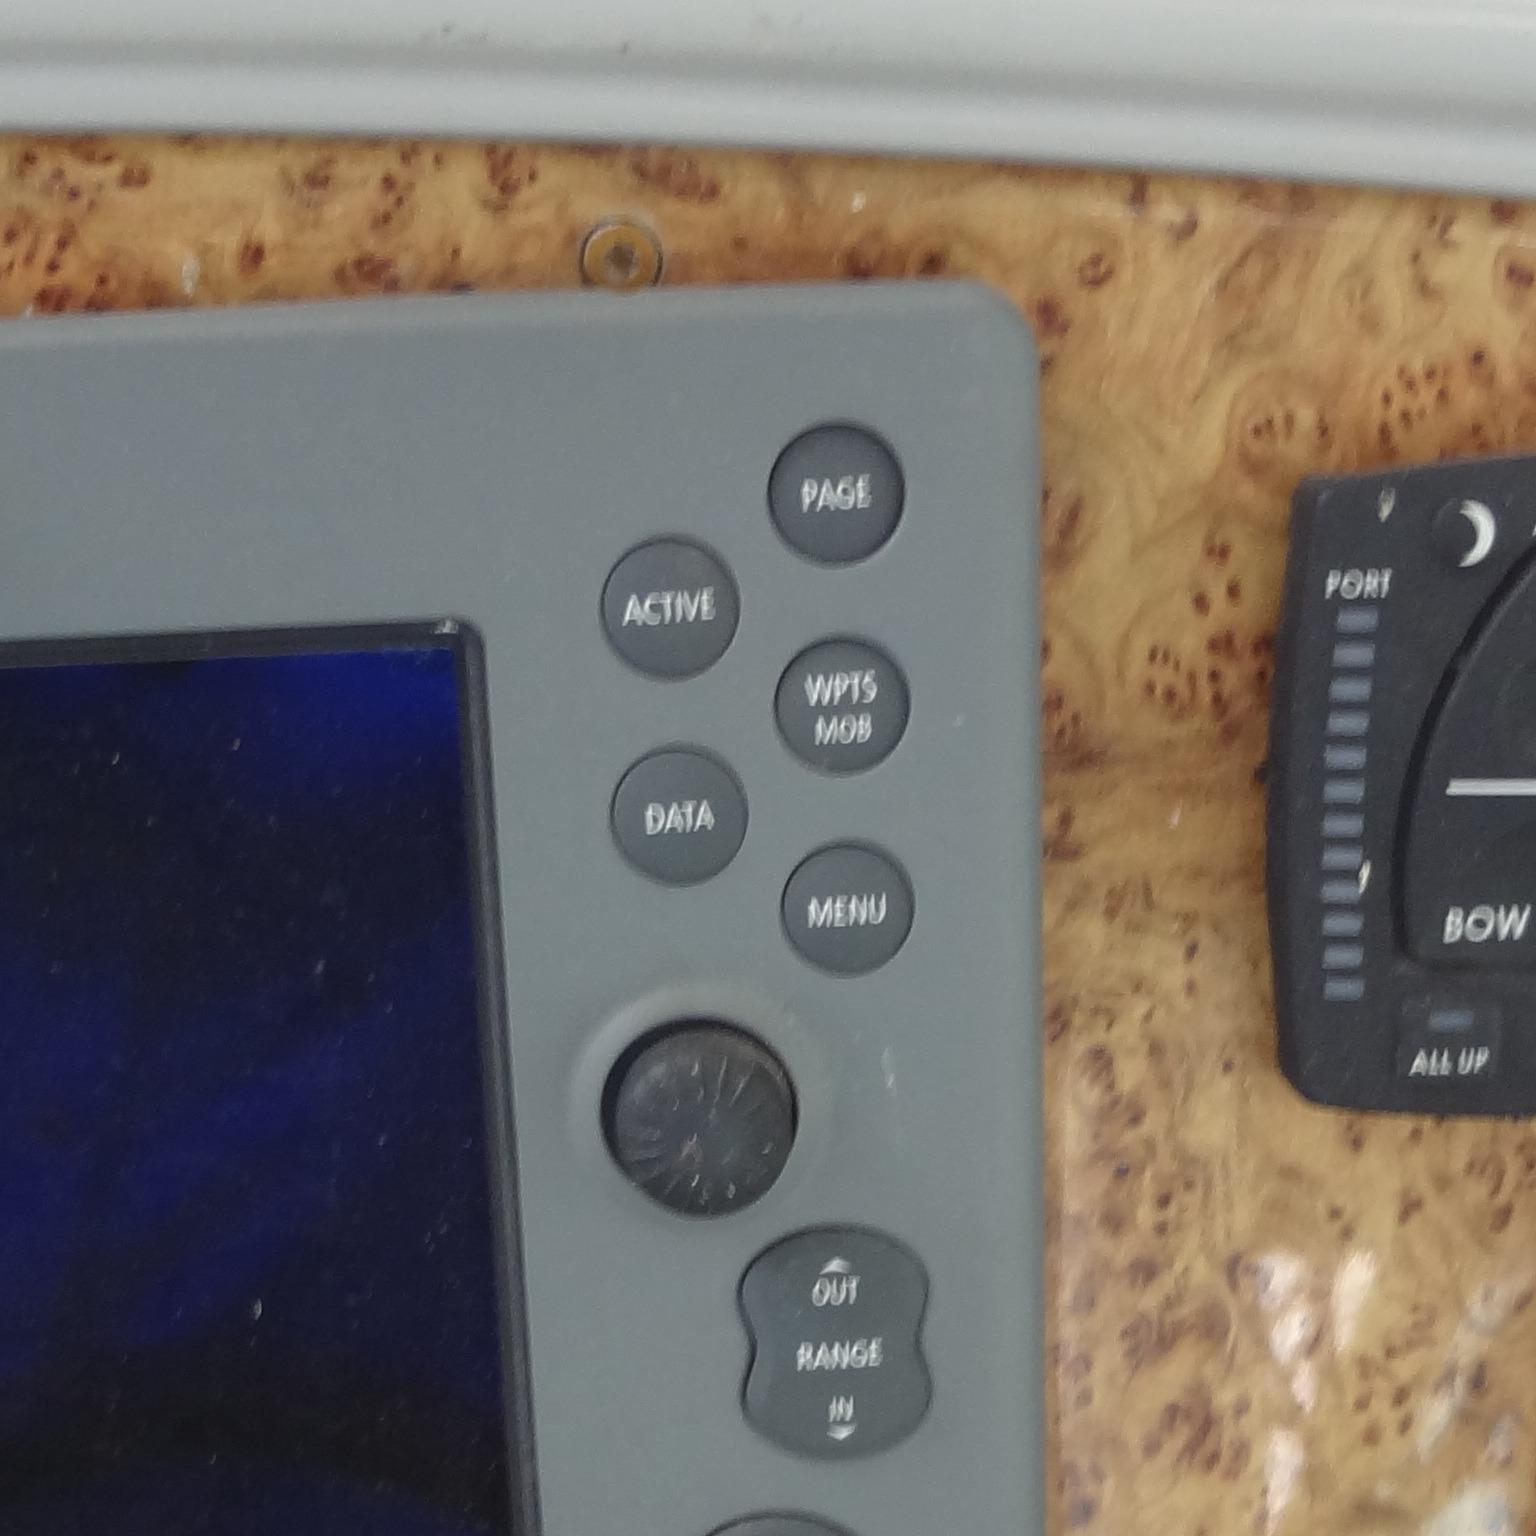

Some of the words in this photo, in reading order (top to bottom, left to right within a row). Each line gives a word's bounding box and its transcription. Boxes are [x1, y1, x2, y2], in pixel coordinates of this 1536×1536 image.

[800, 473, 873, 513] PAGE
[1324, 567, 1394, 601] PORT
[621, 585, 717, 627] ACTIVE
[804, 669, 879, 707] WPTS
[814, 713, 873, 746] MOB
[644, 799, 716, 836] DATA
[806, 891, 888, 930] MENU
[1443, 902, 1532, 945] BOW
[1407, 1047, 1454, 1078] ALL
[1457, 1045, 1491, 1076] UP
[811, 1274, 862, 1308] OUT
[795, 1337, 884, 1372] RANGE
[828, 1395, 855, 1422] IN
